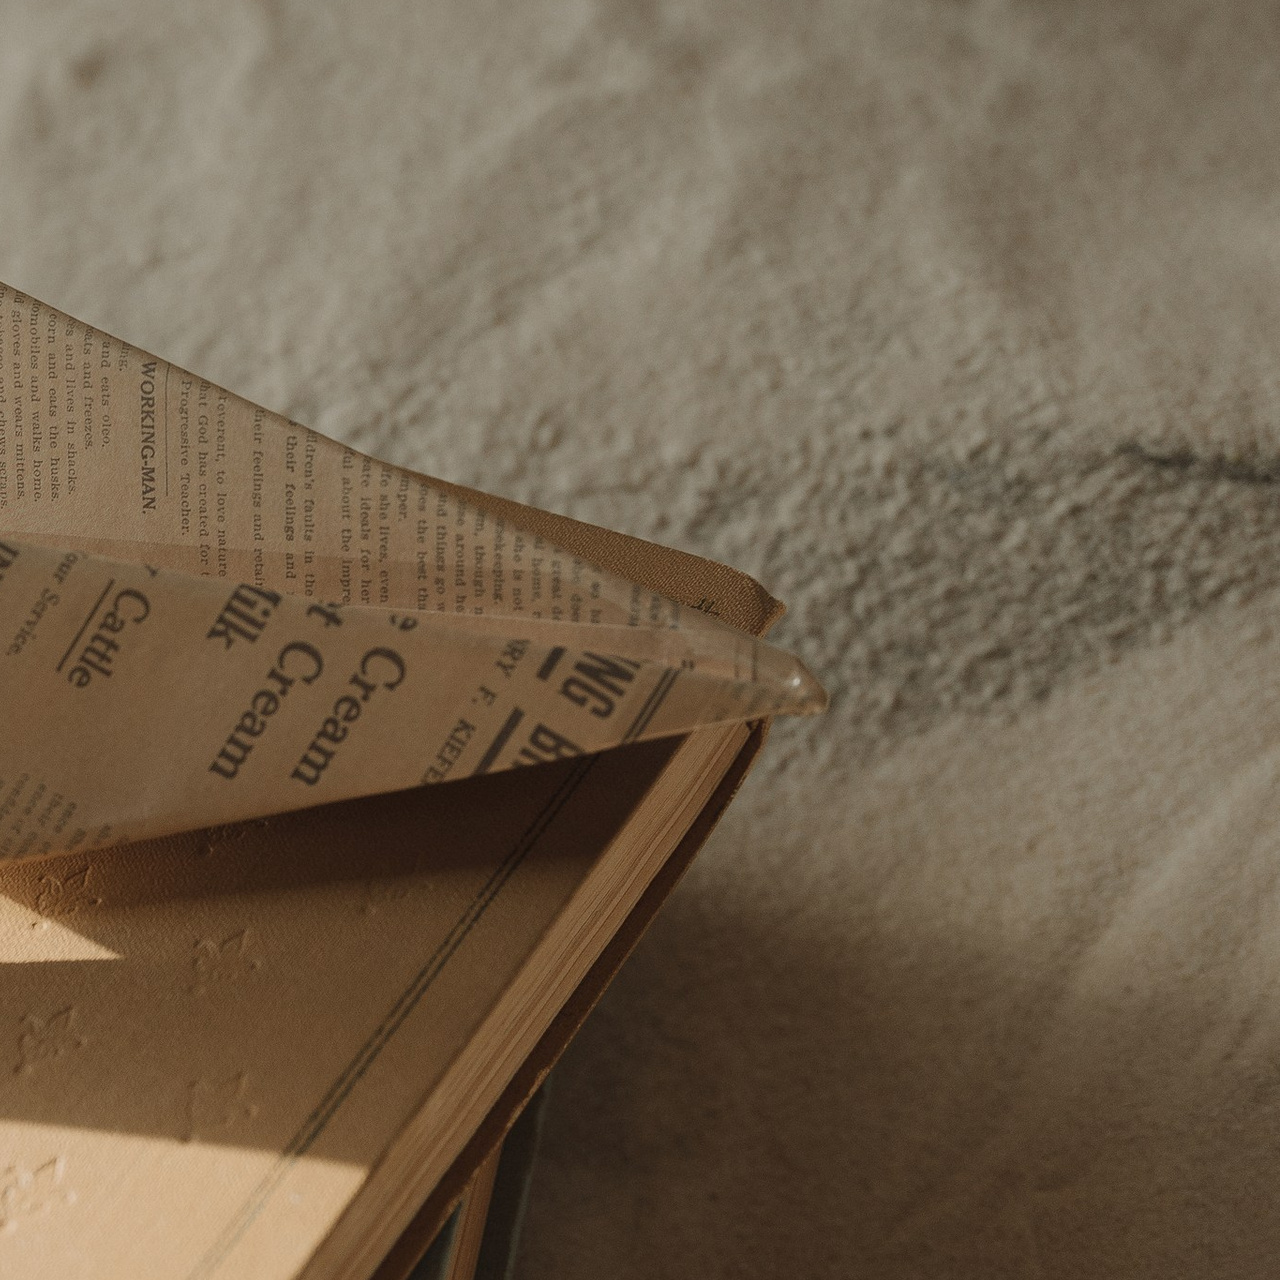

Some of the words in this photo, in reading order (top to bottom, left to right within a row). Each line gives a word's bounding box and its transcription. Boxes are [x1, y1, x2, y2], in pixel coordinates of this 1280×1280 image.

[11, 309, 23, 357] gloves
[47, 311, 60, 344] corn
[47, 352, 59, 380] and
[65, 343, 76, 371] and
[100, 339, 113, 369] and
[12, 362, 24, 389] and
[100, 376, 111, 410] eats
[48, 387, 58, 418] eats
[65, 379, 77, 413] lives
[14, 395, 23, 438] wears
[66, 420, 77, 435] in
[178, 379, 192, 466] Progressive
[197, 414, 209, 444] God
[49, 425, 60, 449] the
[140, 359, 158, 515] WORKING-MAN.
[285, 435, 298, 473] their
[15, 443, 26, 500] mittens.
[50, 457, 61, 502] husks.
[67, 442, 78, 495] shacks.
[198, 451, 209, 477] has
[216, 469, 226, 485] to
[180, 472, 192, 536] Teacher.
[198, 483, 210, 538] created
[216, 492, 228, 523] love
[283, 483, 297, 542] feelings
[199, 543, 211, 566] for
[285, 552, 297, 579] and
[4, 587, 61, 656] Service.
[67, 587, 152, 689] Cattle
[471, 685, 498, 706] F.
[558, 646, 642, 719] NG
[207, 640, 325, 780] Cream
[289, 646, 407, 786] Cream
[517, 723, 585, 767] B
